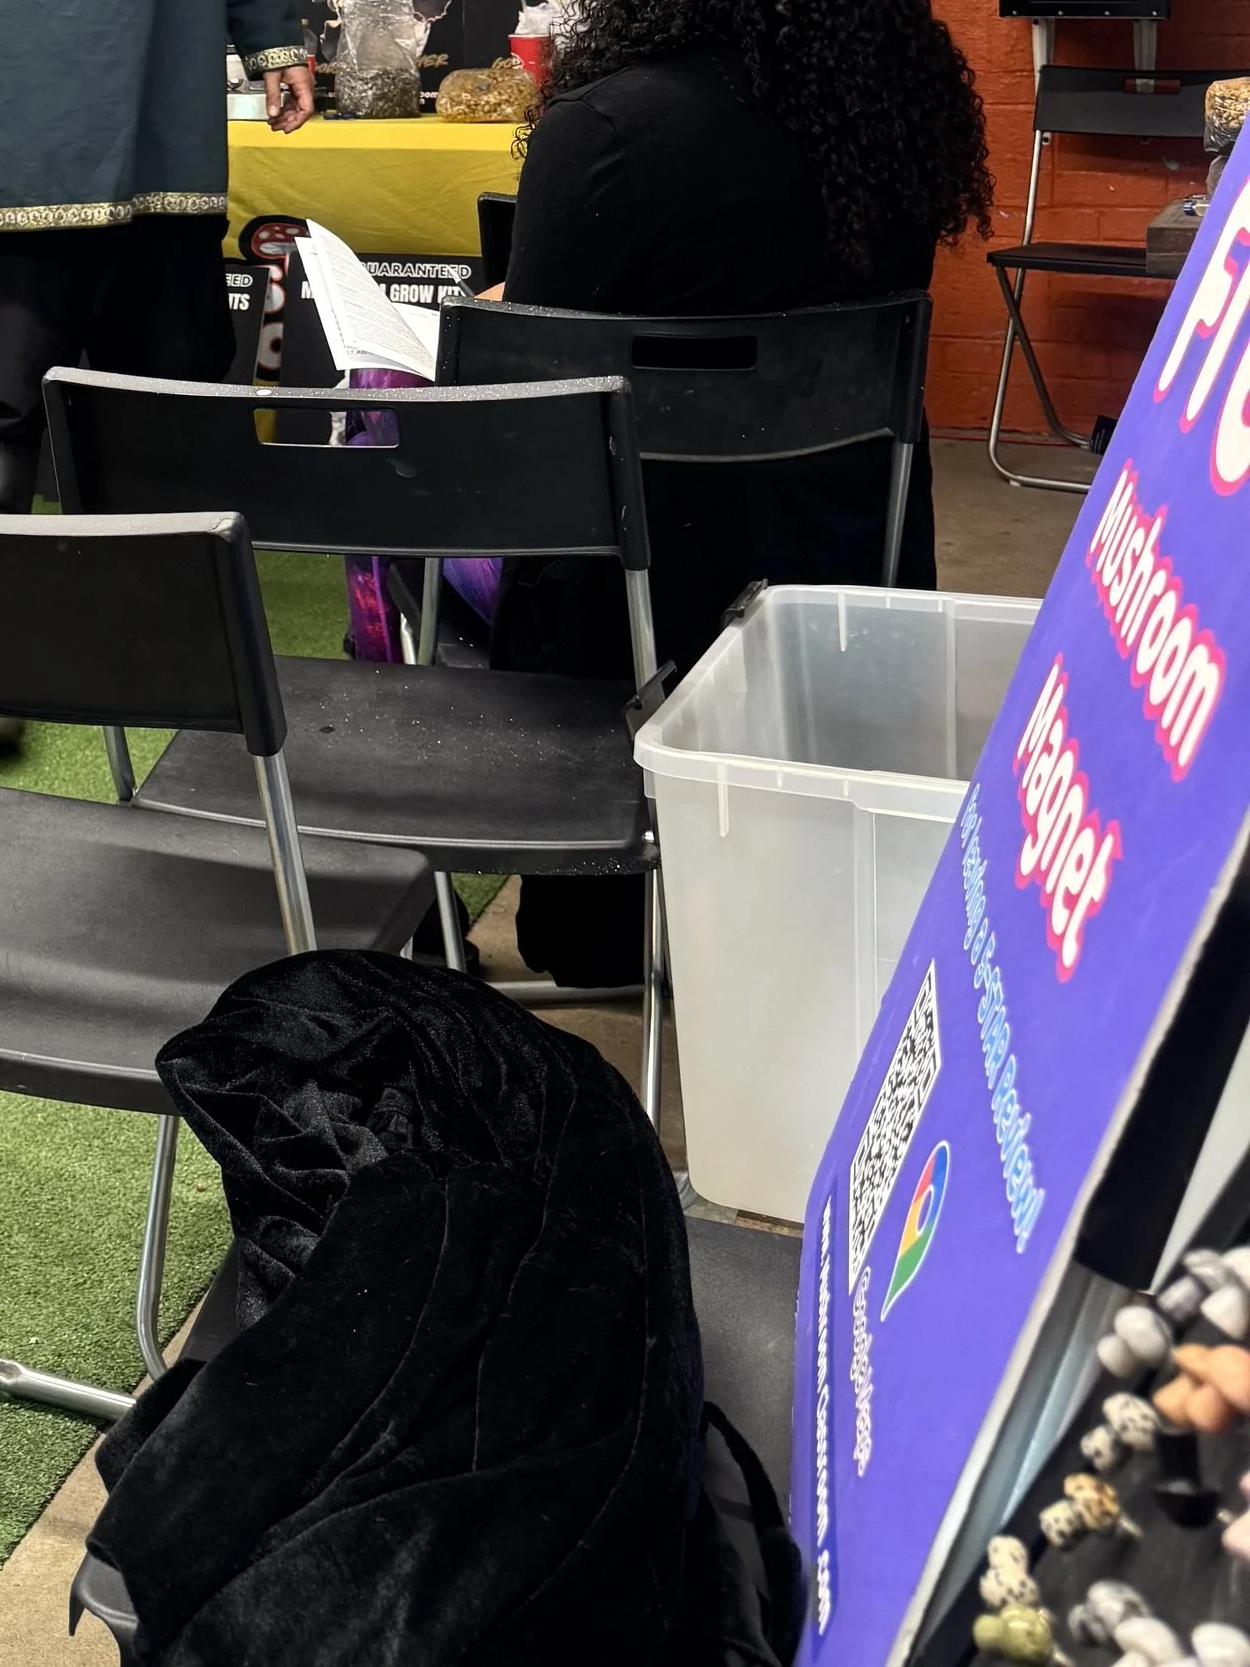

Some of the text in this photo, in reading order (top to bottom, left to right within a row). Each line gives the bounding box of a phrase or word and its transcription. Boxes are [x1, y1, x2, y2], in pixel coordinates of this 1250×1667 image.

[228, 293, 250, 310] ITS
[390, 283, 434, 303] GROW
[1088, 464, 1224, 775] Mushroom
[1014, 657, 1119, 976] Magnet
[970, 917, 989, 966] a
[973, 931, 1010, 1090] 5-STAR
[991, 1054, 1045, 1254] Review!
